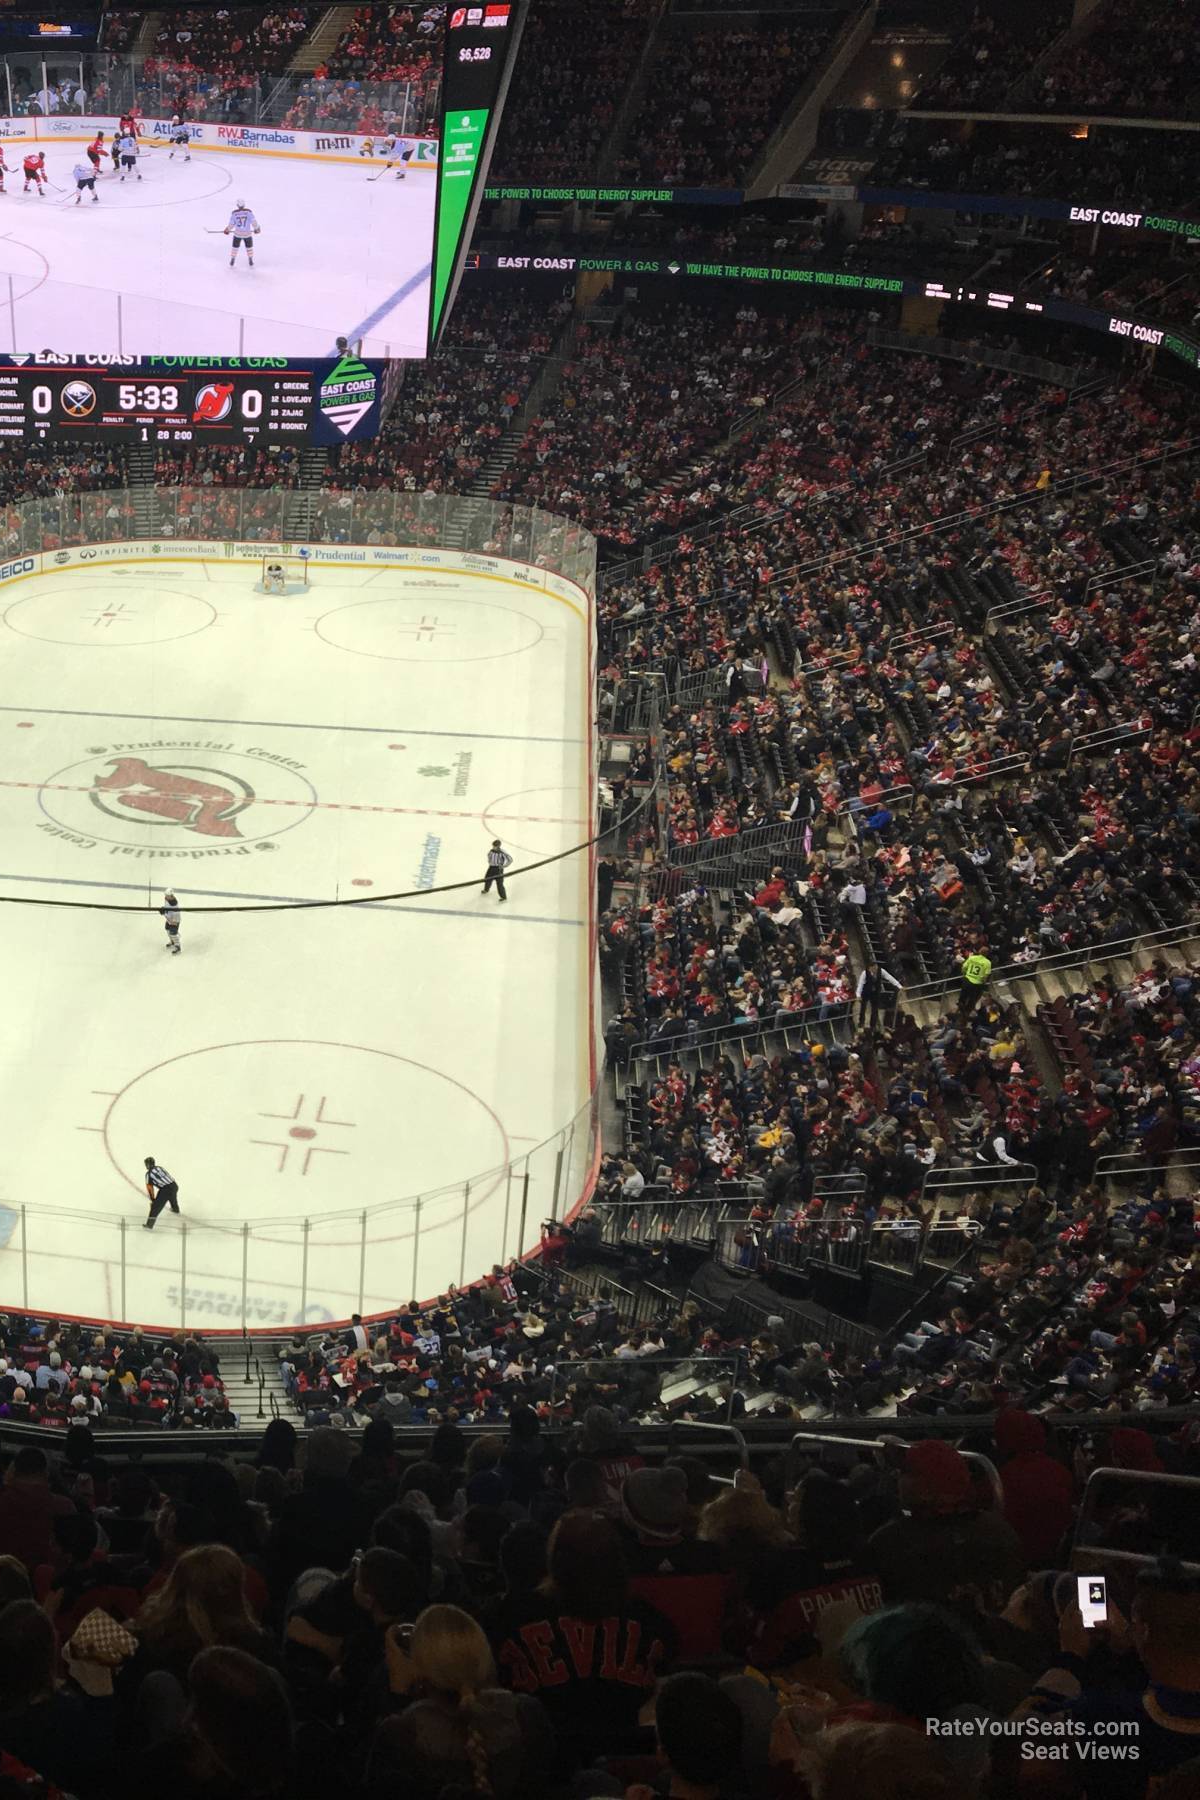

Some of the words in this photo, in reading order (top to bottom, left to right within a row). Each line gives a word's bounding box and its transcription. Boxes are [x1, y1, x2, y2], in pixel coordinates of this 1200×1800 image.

[460, 47, 491, 62] $6,528
[154, 122, 202, 138] Atlic
[218, 127, 295, 144] RWJBarnabas
[228, 139, 259, 148] HEALTH
[485, 189, 500, 199] THE
[501, 188, 530, 199] POWER
[532, 189, 541, 199] TO
[543, 189, 574, 200] CHOOSE
[576, 190, 597, 200] YOUR
[599, 190, 630, 200] ENERGY
[631, 190, 674, 201] SUPPLIER!
[237, 216, 247, 227] 37
[1070, 207, 1100, 223] EAST
[1102, 212, 1142, 227] COAST
[1145, 216, 1177, 232] POWER
[498, 257, 530, 268] EAST
[534, 258, 576, 270] COAST
[580, 261, 622, 270] POWER
[625, 261, 632, 271] &
[636, 261, 659, 271] GAS
[687, 263, 701, 274] YOU
[703, 265, 723, 276] HAVE
[725, 266, 739, 277] THE
[740, 267, 768, 279] POWER
[771, 269, 781, 279] TO
[783, 270, 814, 282] CHOOSE
[815, 272, 834, 284] YOUR
[836, 274, 863, 288] ENERGY
[865, 277, 904, 292] SUPPLIER!
[1109, 318, 1132, 336] EAST
[1133, 326, 1164, 345] COAST
[35, 354, 77, 365] EAST
[85, 354, 143, 366] COAST
[146, 356, 222, 367] POWER
[228, 356, 242, 367] &
[247, 357, 288, 368] GAS
[320, 385, 345, 396] EAST
[346, 379, 377, 392] COAST
[33, 386, 52, 414] 0
[120, 385, 178, 411] 5:33
[242, 390, 262, 418] 0
[282, 396, 312, 404] LOVEJOY
[320, 397, 350, 408] POWER
[351, 395, 358, 403] &
[359, 392, 376, 402] GAS
[281, 423, 308, 431] ROONEY
[141, 428, 148, 441] 1
[157, 431, 170, 440] 28
[175, 431, 192, 440] 2:00
[248, 435, 254, 443] 7
[316, 550, 366, 561] Prudential
[374, 552, 408, 561] Walmart
[112, 739, 235, 752] Prudential
[246, 746, 307, 771] Center
[36, 822, 98, 850] Center
[109, 846, 251, 860] Prudential
